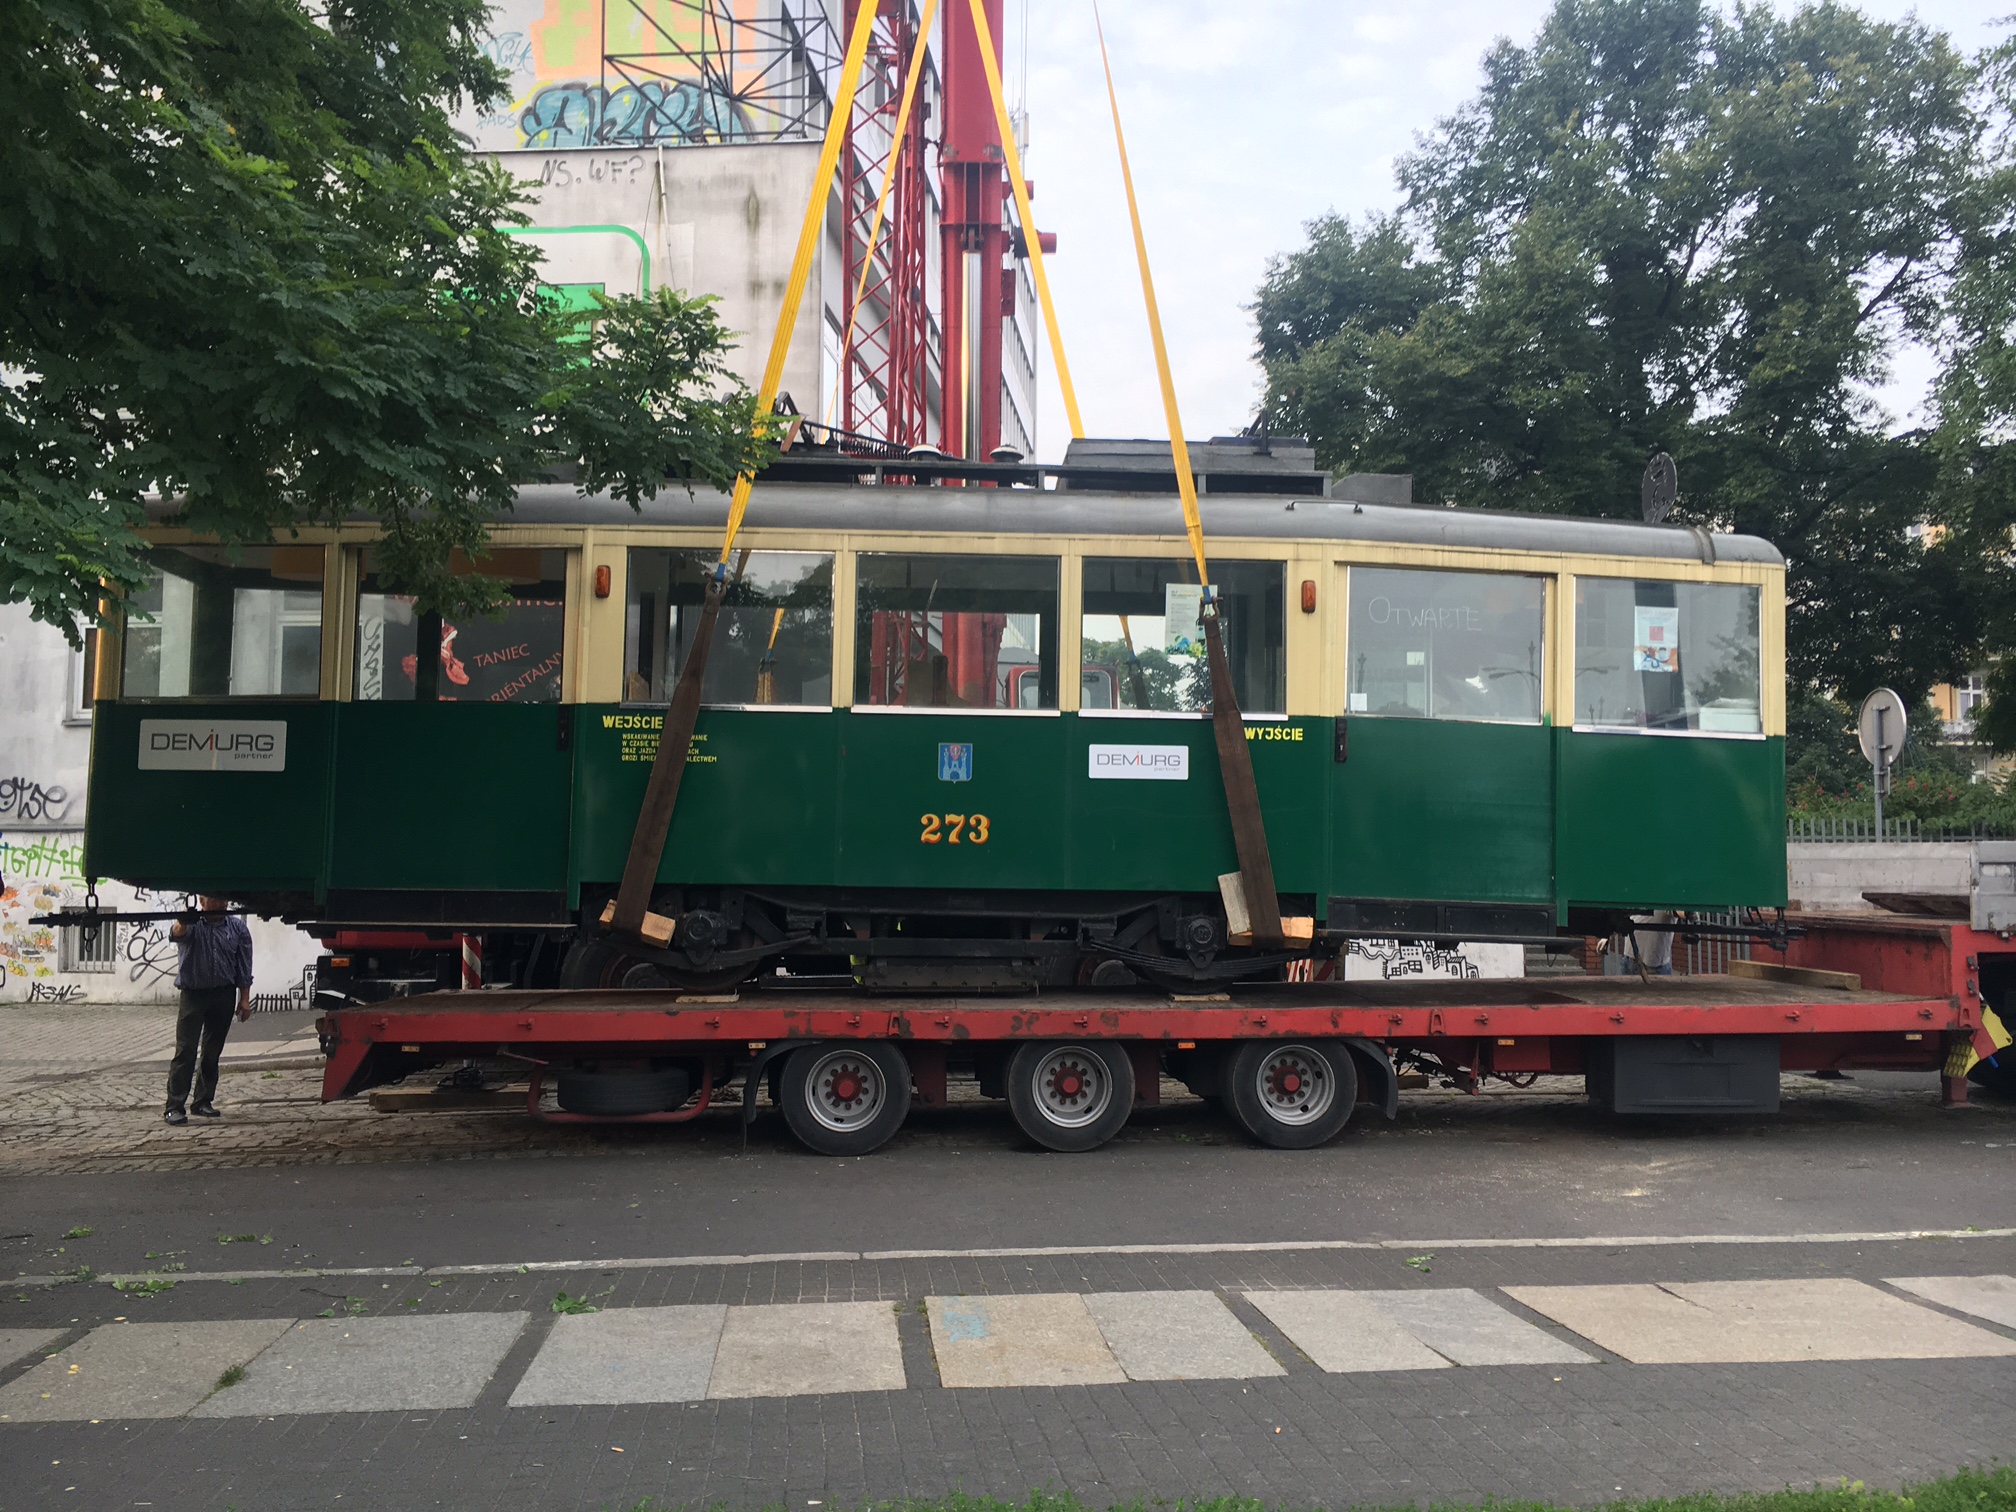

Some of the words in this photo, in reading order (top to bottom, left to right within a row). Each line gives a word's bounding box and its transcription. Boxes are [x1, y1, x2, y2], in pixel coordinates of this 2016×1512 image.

[473, 643, 530, 668] TANIEC
[486, 652, 561, 701] RIENTALN
[602, 713, 663, 729] WEJŚCIE
[1243, 724, 1303, 741] WYJŚCIE
[234, 752, 274, 760] partner
[920, 813, 991, 845] 273
